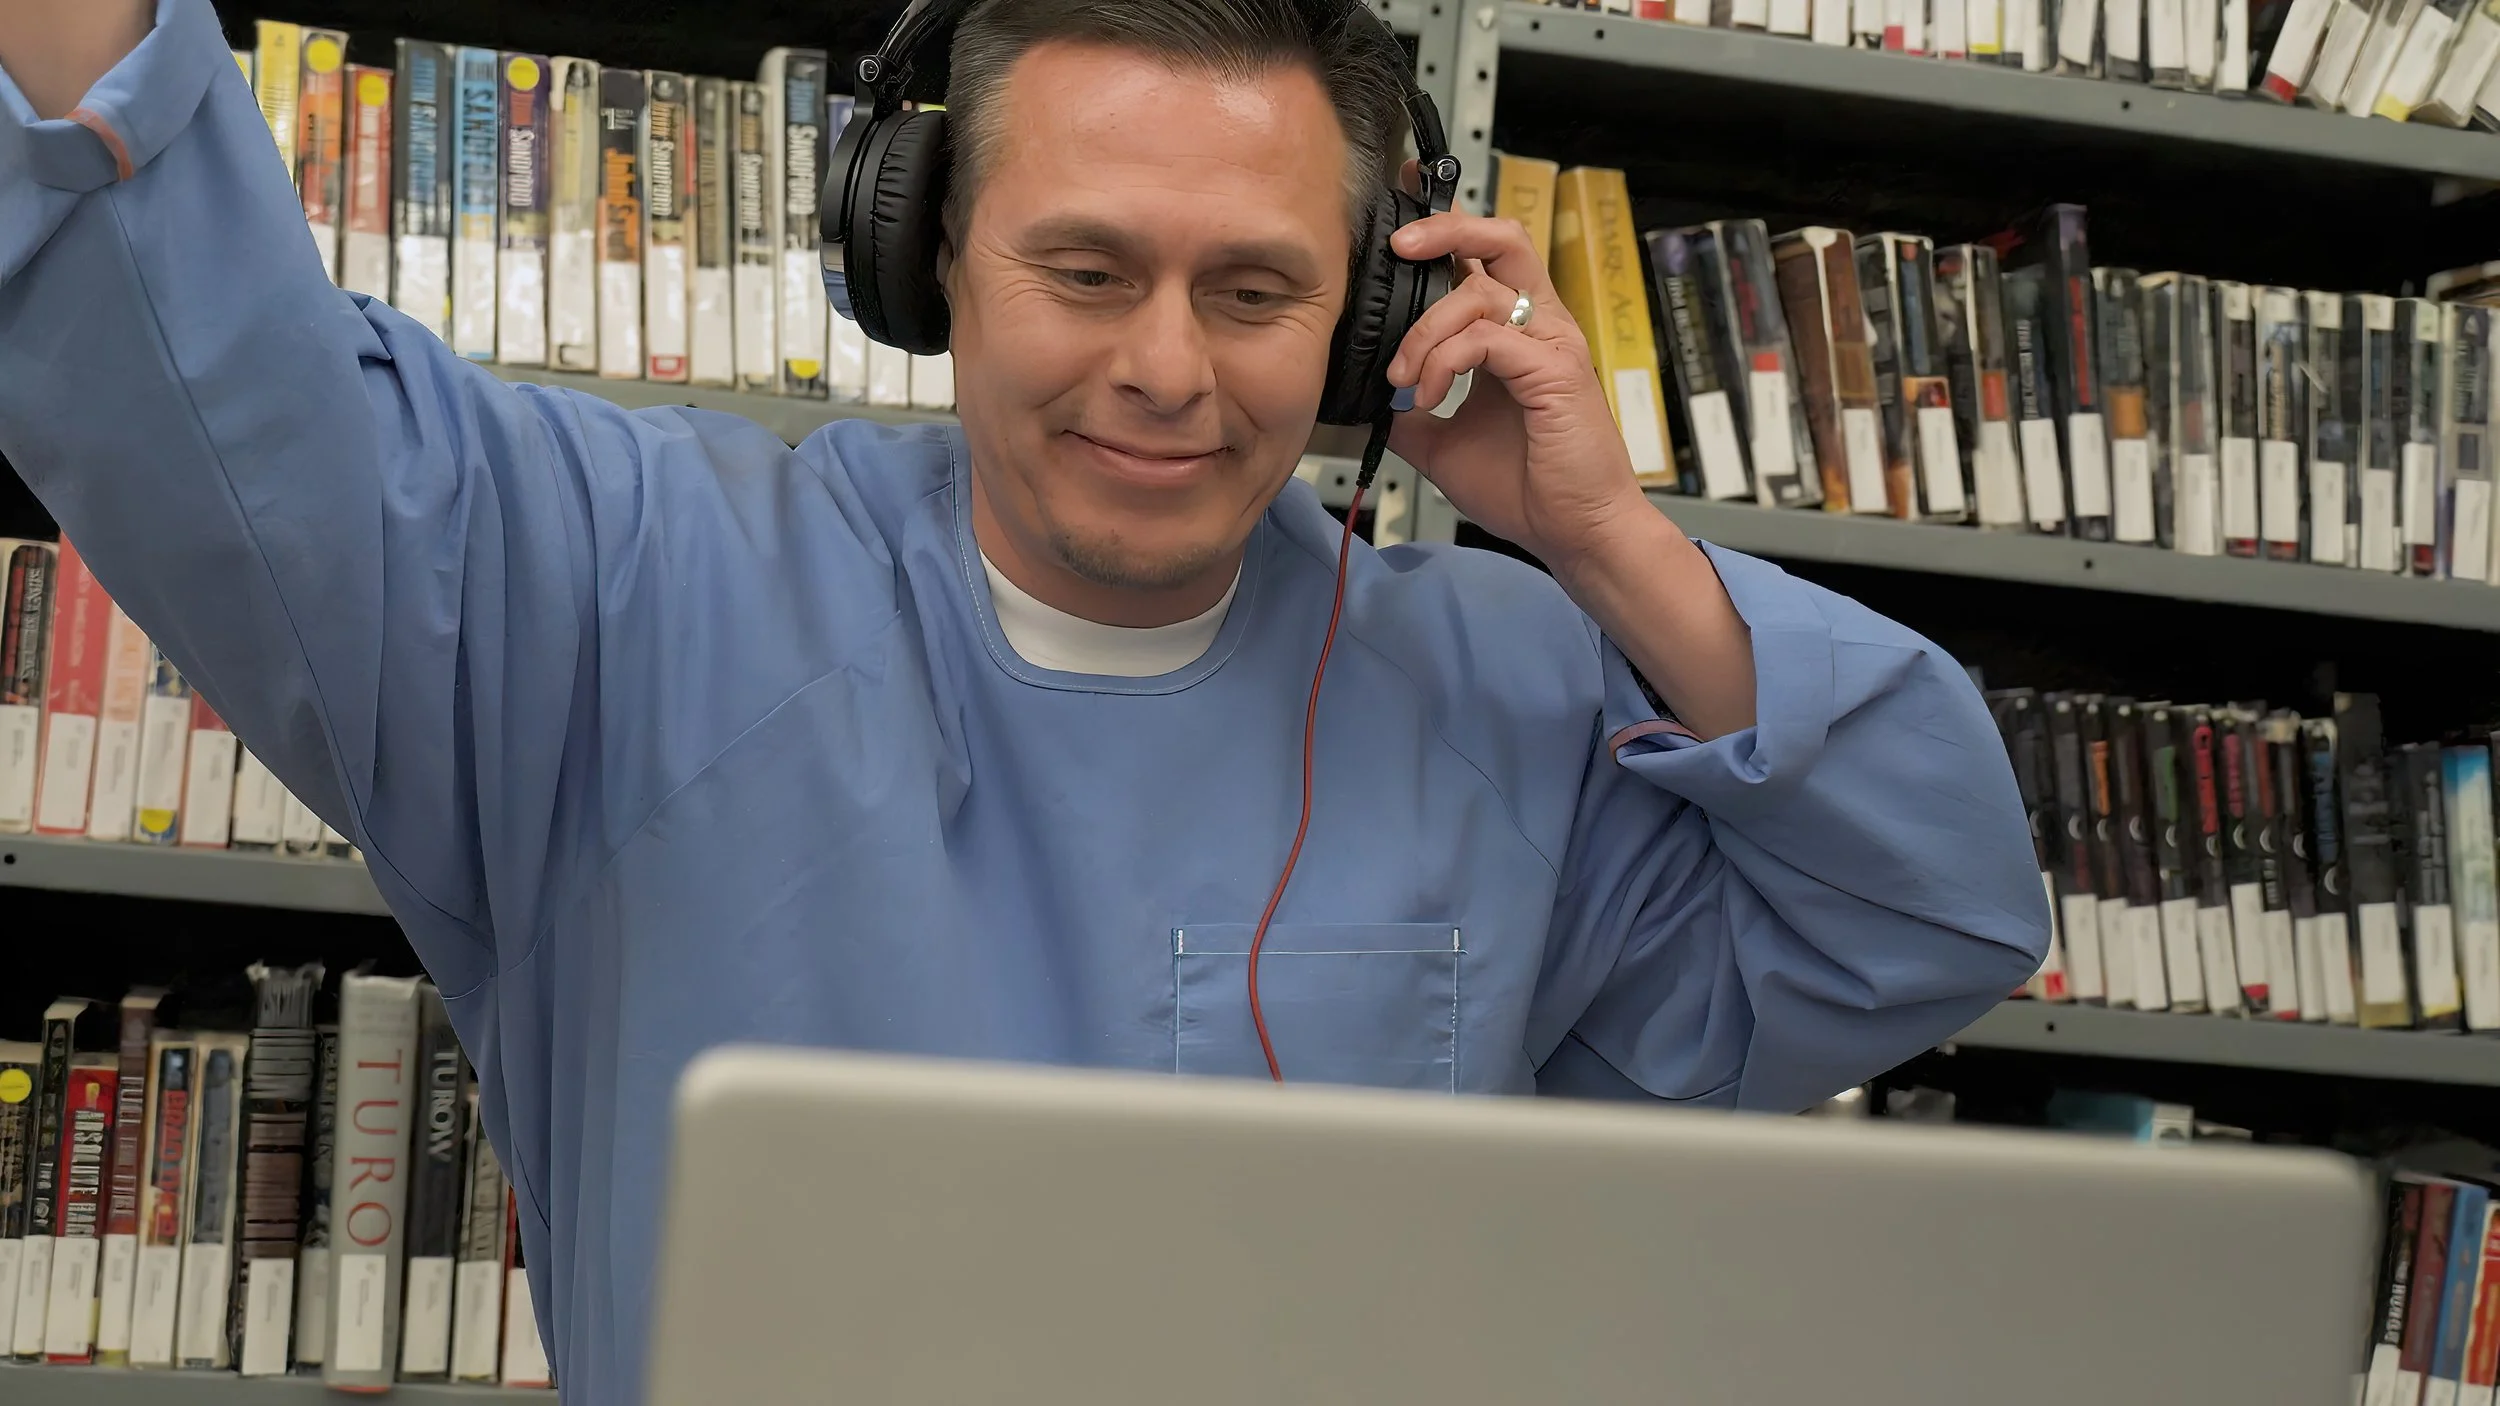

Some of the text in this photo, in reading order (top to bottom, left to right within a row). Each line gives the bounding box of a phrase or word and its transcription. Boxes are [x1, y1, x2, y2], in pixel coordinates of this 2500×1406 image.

[786, 124, 819, 215] SANDFORD
[1598, 198, 1637, 346] DARK AGE
[69, 1109, 106, 1195] ABSOLUTE
[346, 1047, 402, 1248] TURO
[427, 1048, 460, 1163] TUROW
